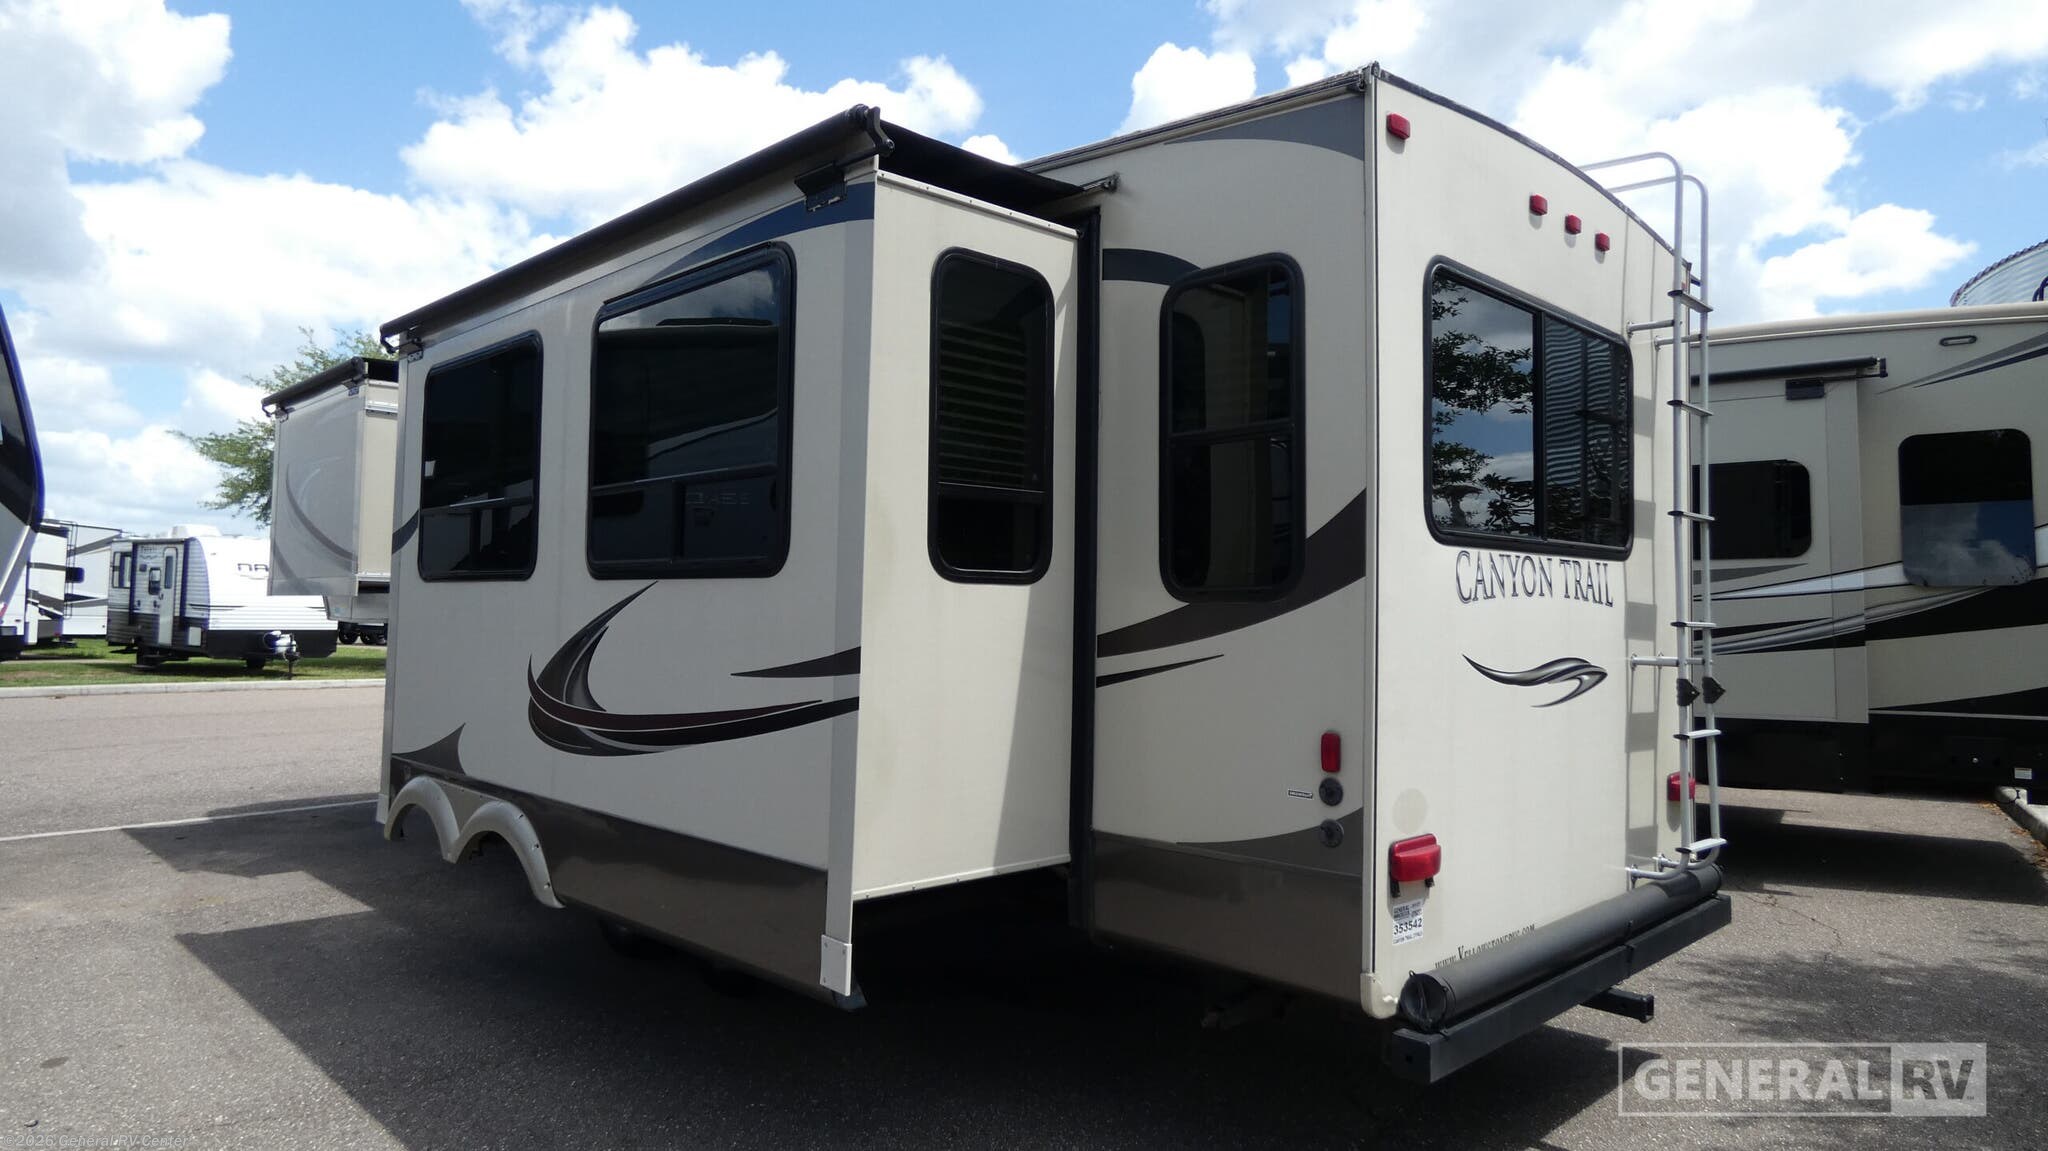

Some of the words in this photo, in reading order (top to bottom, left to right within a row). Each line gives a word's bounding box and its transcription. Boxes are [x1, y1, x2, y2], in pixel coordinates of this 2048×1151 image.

[237, 563, 269, 572] NA
[1455, 550, 1555, 604] CANYON
[1559, 558, 1614, 608] TRAIL
